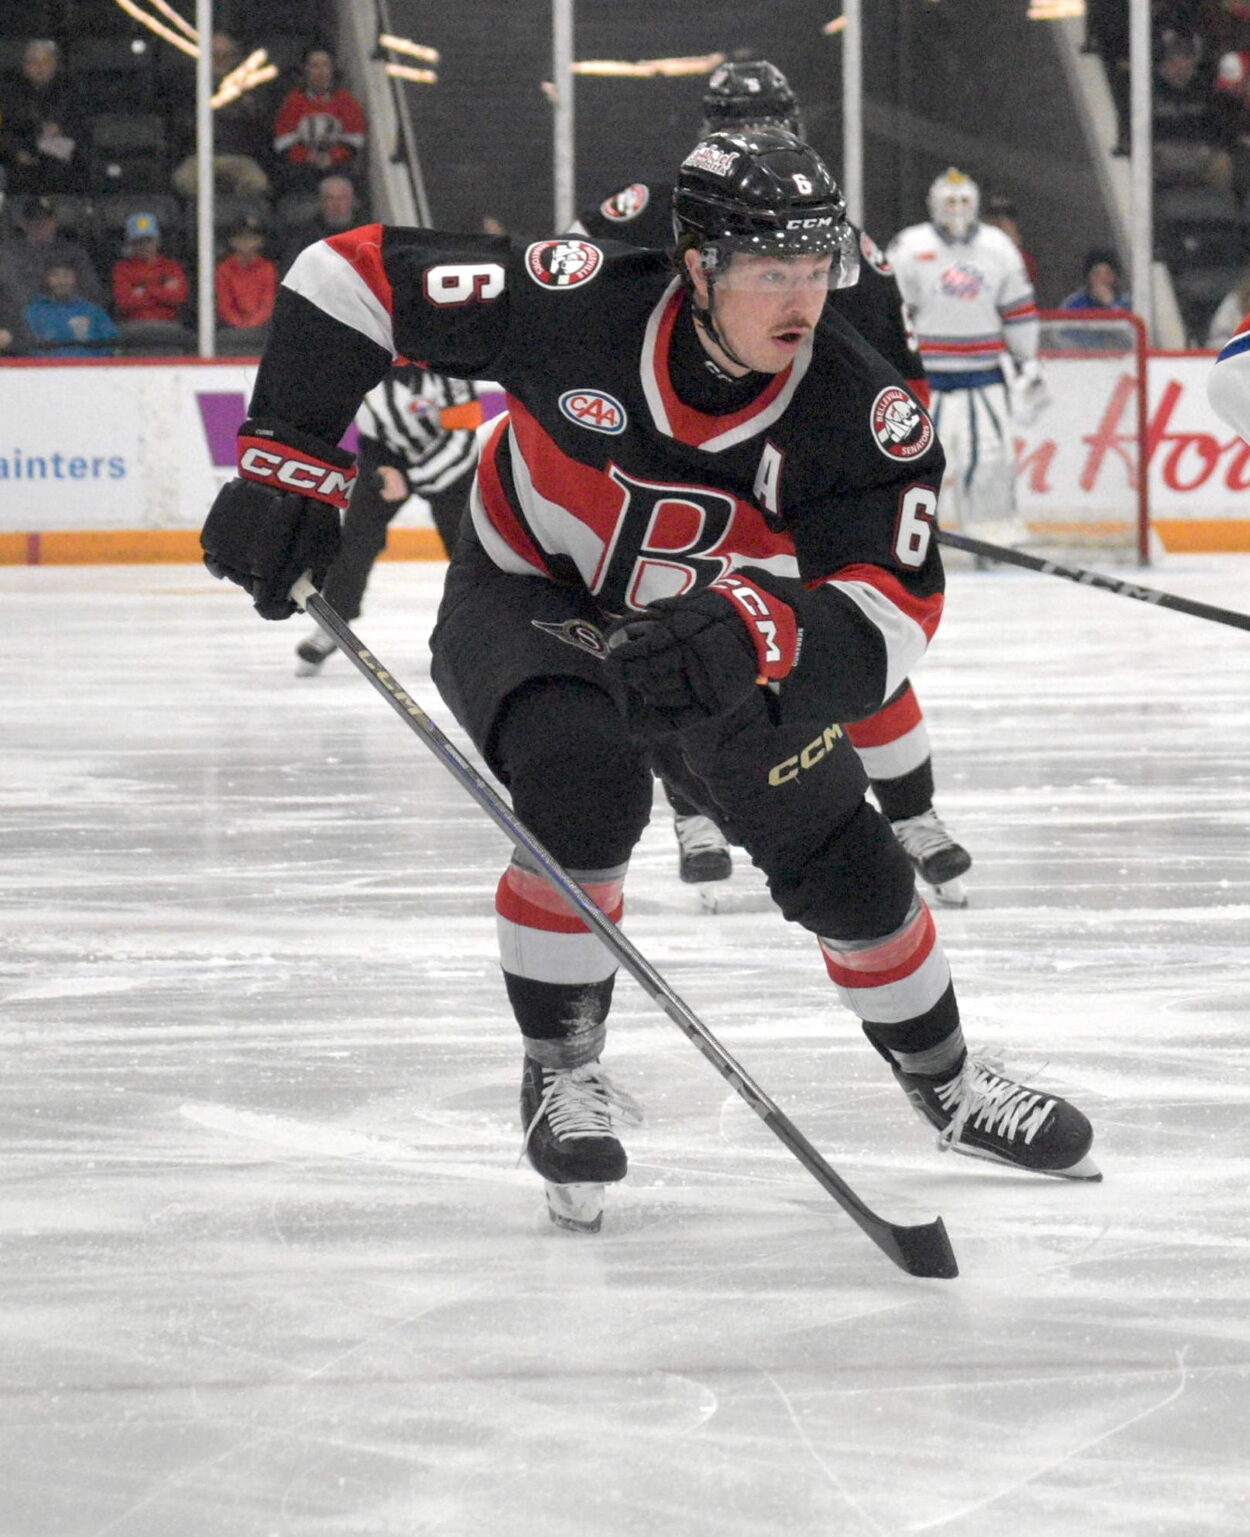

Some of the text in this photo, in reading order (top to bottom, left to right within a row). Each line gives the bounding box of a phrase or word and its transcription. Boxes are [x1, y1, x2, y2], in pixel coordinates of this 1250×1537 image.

[791, 173, 812, 195] 6
[786, 216, 833, 231] CCM
[423, 262, 505, 308] 6
[570, 396, 617, 427] CAA
[875, 391, 905, 423] BELLEVILLE
[901, 425, 930, 456] SENATORS
[240, 447, 357, 500] CCM
[753, 441, 783, 516] A
[590, 460, 738, 613] B
[892, 482, 940, 572] 6
[768, 723, 844, 787] CCM
